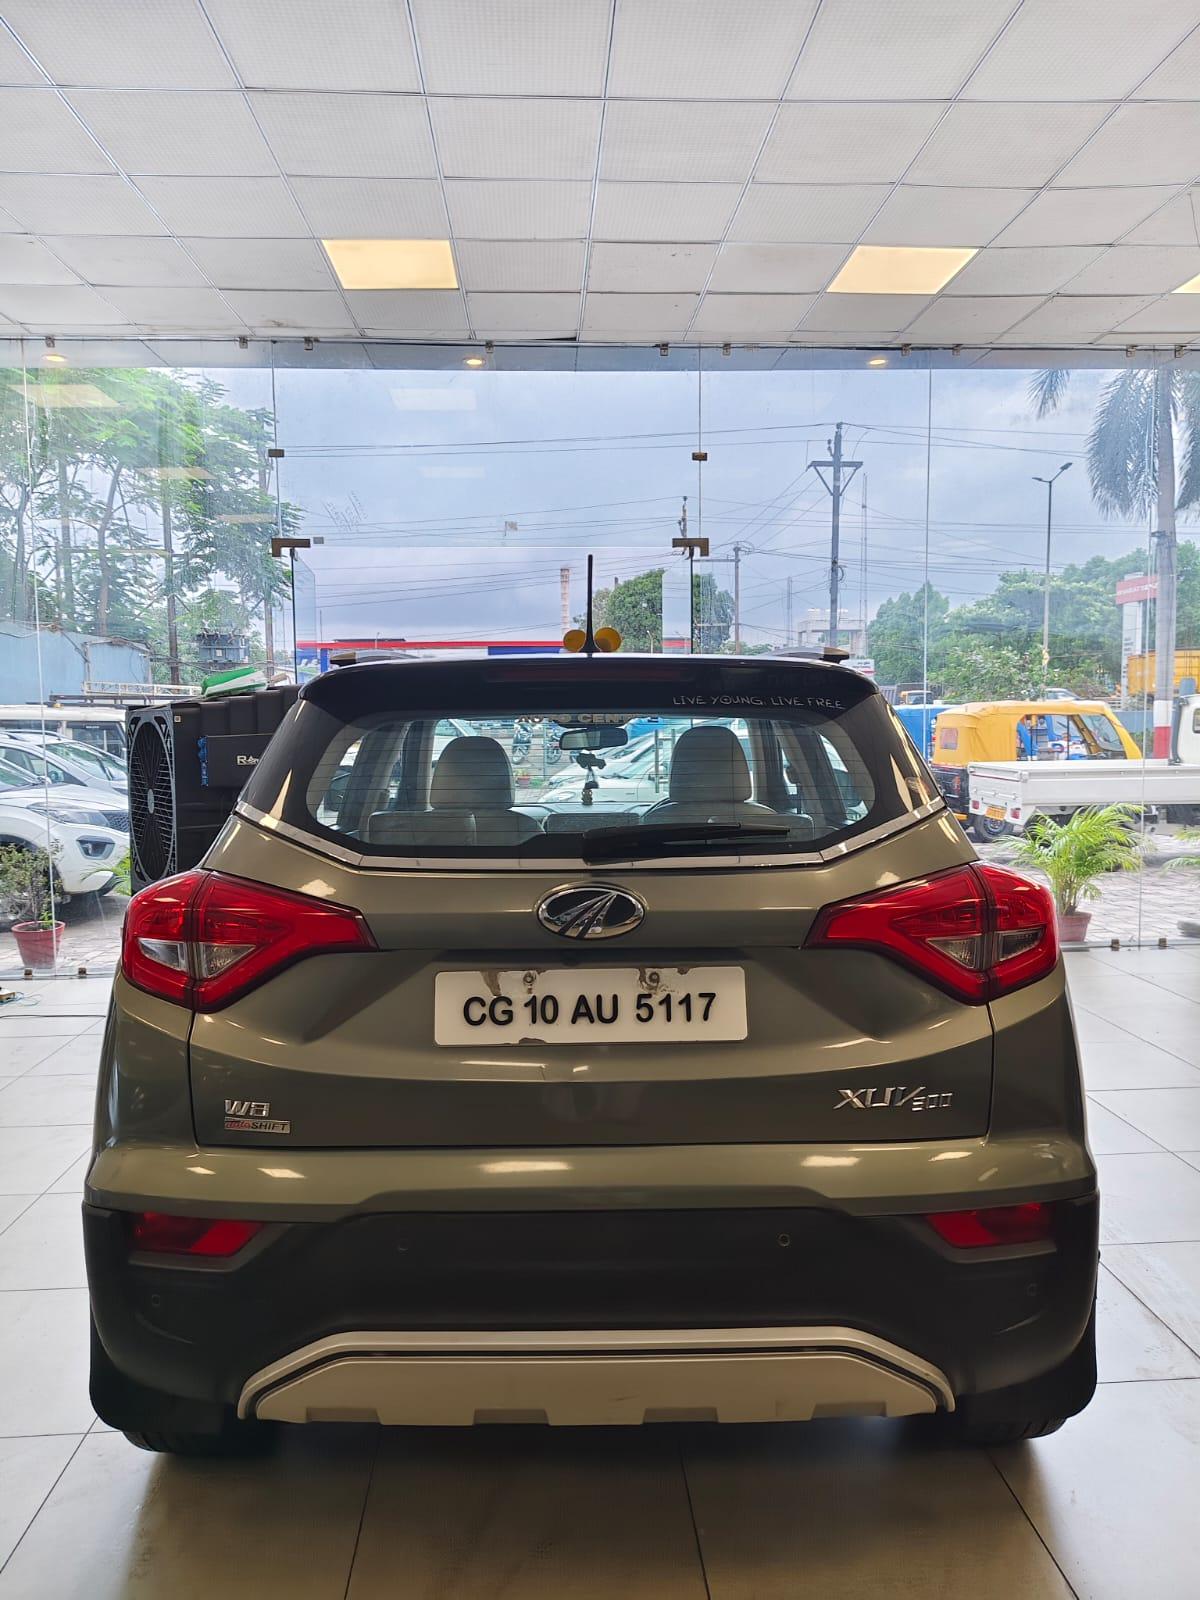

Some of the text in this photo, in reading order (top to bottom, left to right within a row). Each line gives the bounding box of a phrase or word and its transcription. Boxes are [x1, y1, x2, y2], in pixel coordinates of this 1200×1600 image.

[672, 696, 706, 705] LIVE
[771, 696, 804, 706] LIVE
[808, 697, 844, 709] FREE
[463, 993, 717, 1026] CG 10 AU 5117
[225, 1099, 270, 1117] W8
